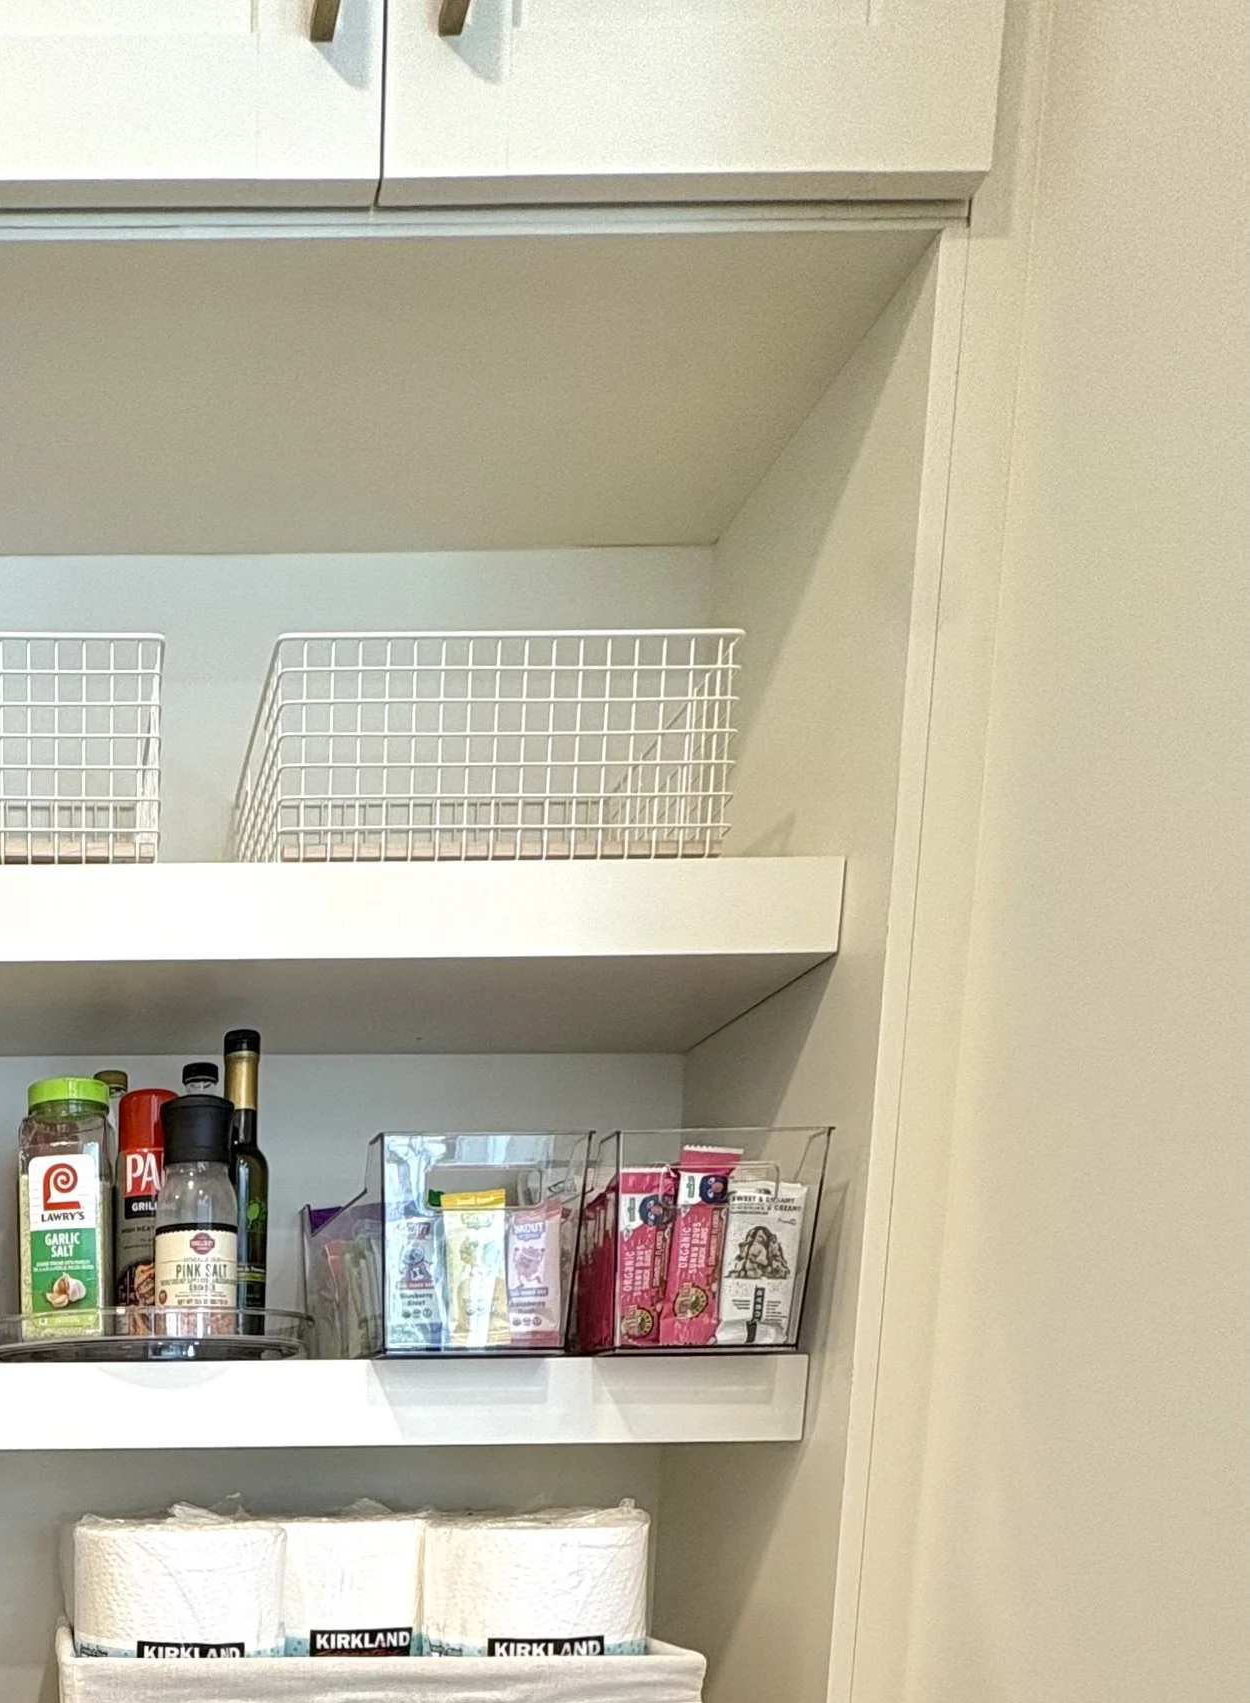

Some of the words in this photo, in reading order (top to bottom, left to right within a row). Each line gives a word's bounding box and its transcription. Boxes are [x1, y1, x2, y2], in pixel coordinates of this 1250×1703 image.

[126, 1152, 166, 1194] PA
[41, 1211, 85, 1222] LAWRY'S
[45, 1232, 80, 1246] GARLIC
[51, 1245, 74, 1257] SALT
[176, 1264, 201, 1278] PINK
[205, 1264, 227, 1278] SALT
[316, 1631, 410, 1649] KIRKLAND
[143, 1645, 240, 1658] KIRKLAND
[494, 1641, 600, 1657] KIRKLAND
